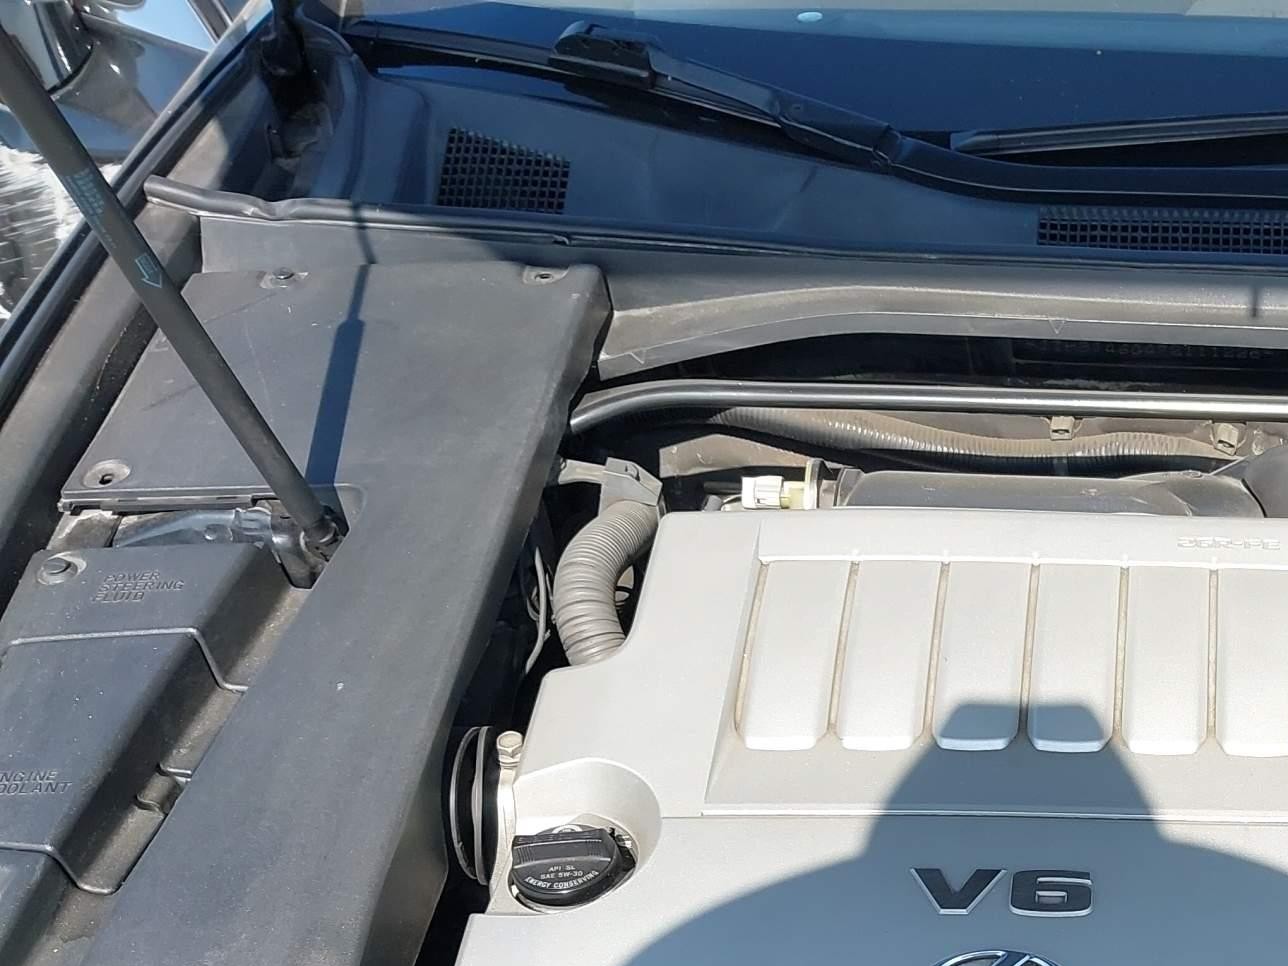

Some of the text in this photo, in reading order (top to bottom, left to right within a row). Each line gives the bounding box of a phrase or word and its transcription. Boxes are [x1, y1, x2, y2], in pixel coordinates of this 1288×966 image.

[104, 571, 161, 582] POWER
[101, 580, 185, 591] STEERING
[92, 591, 145, 602] FLUID
[524, 870, 600, 889] ENERGY CONSERVING
[558, 870, 583, 878] 5W-30
[909, 867, 1093, 918] V6
